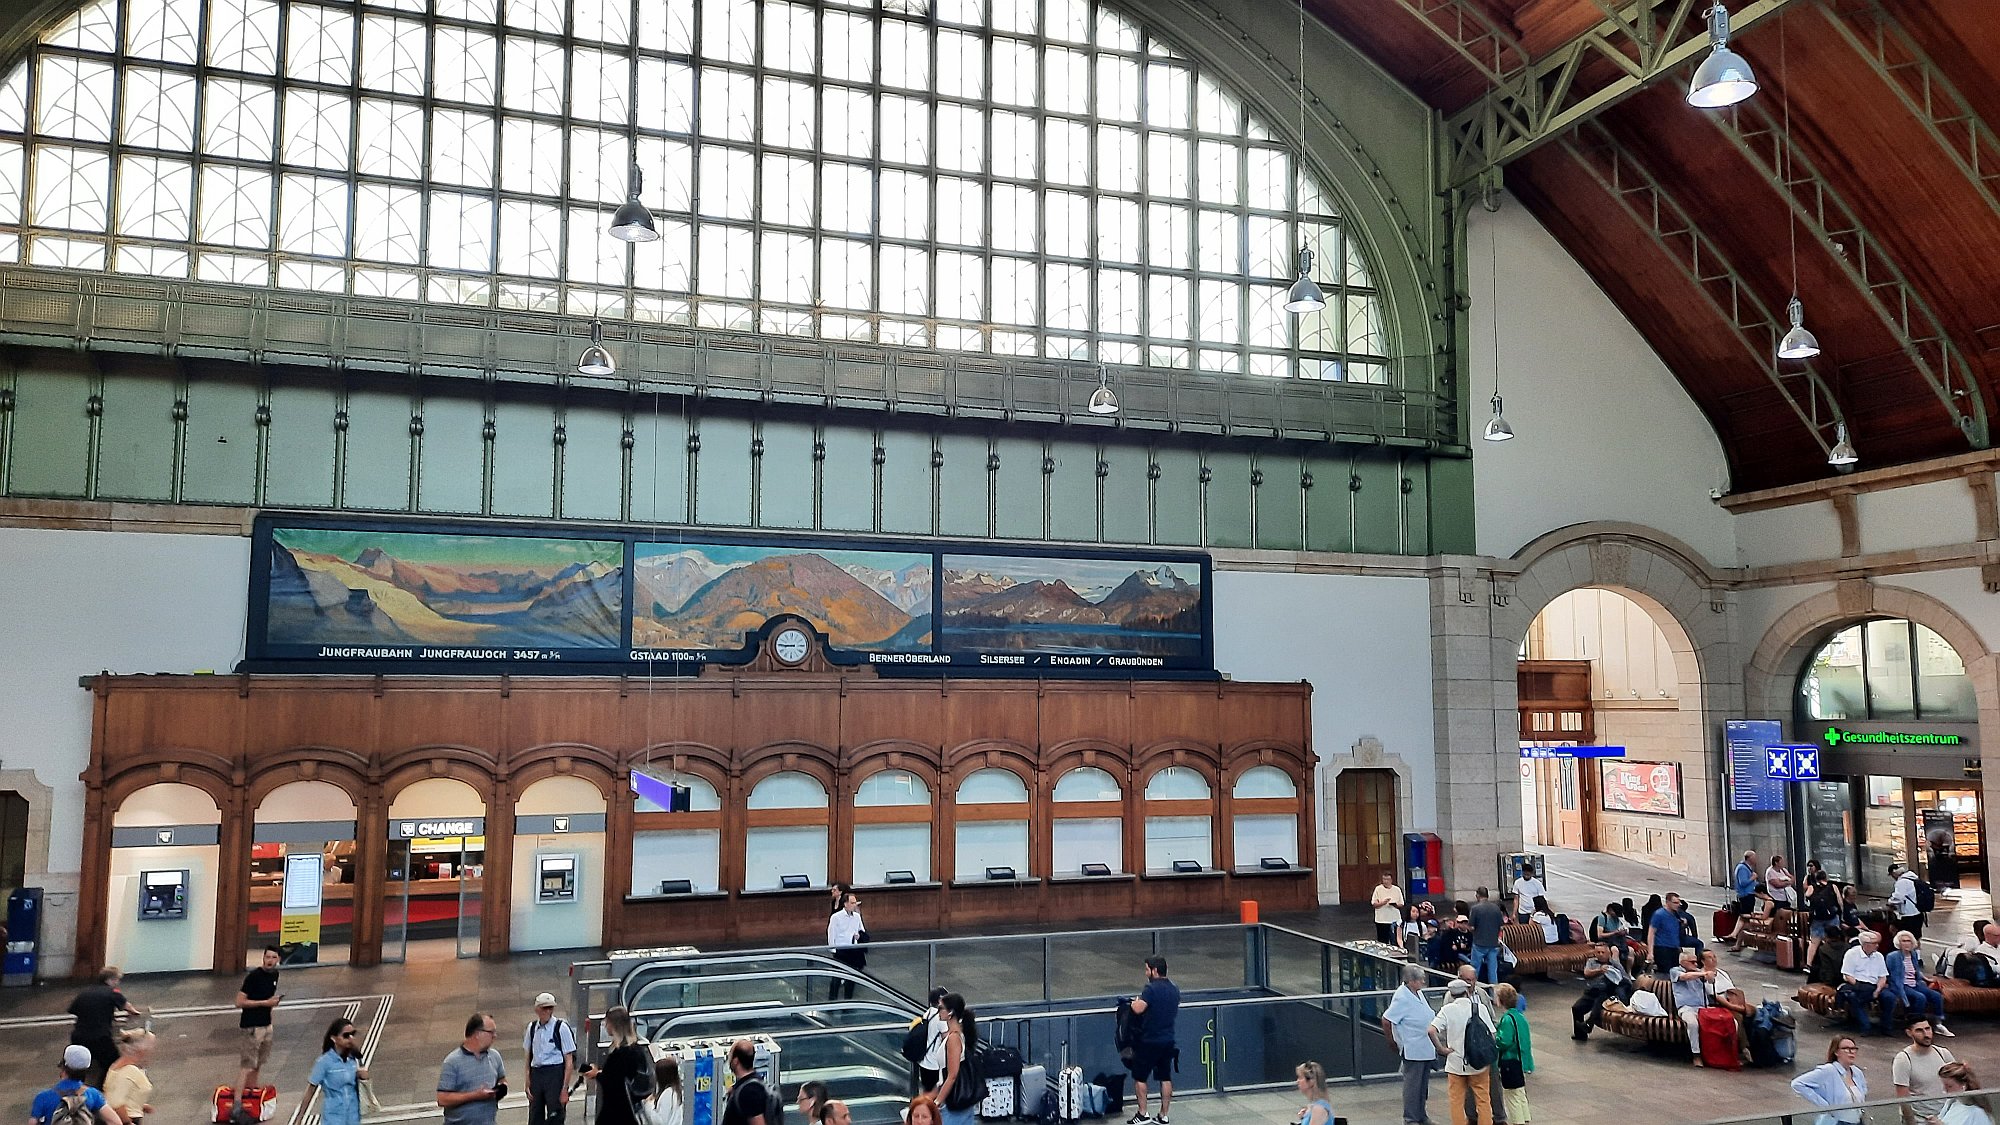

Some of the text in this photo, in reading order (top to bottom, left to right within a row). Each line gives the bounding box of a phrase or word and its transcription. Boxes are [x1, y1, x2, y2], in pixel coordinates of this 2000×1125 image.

[318, 646, 413, 658] JUNGFRAUBAHN
[513, 650, 540, 660] 3457
[629, 650, 669, 661] GSTAAD
[980, 654, 1025, 664] SILSERSEE
[1050, 655, 1091, 665] ENGADIN
[1842, 731, 1959, 745] Gesundheitszentrum
[418, 822, 474, 836] CHANGE
